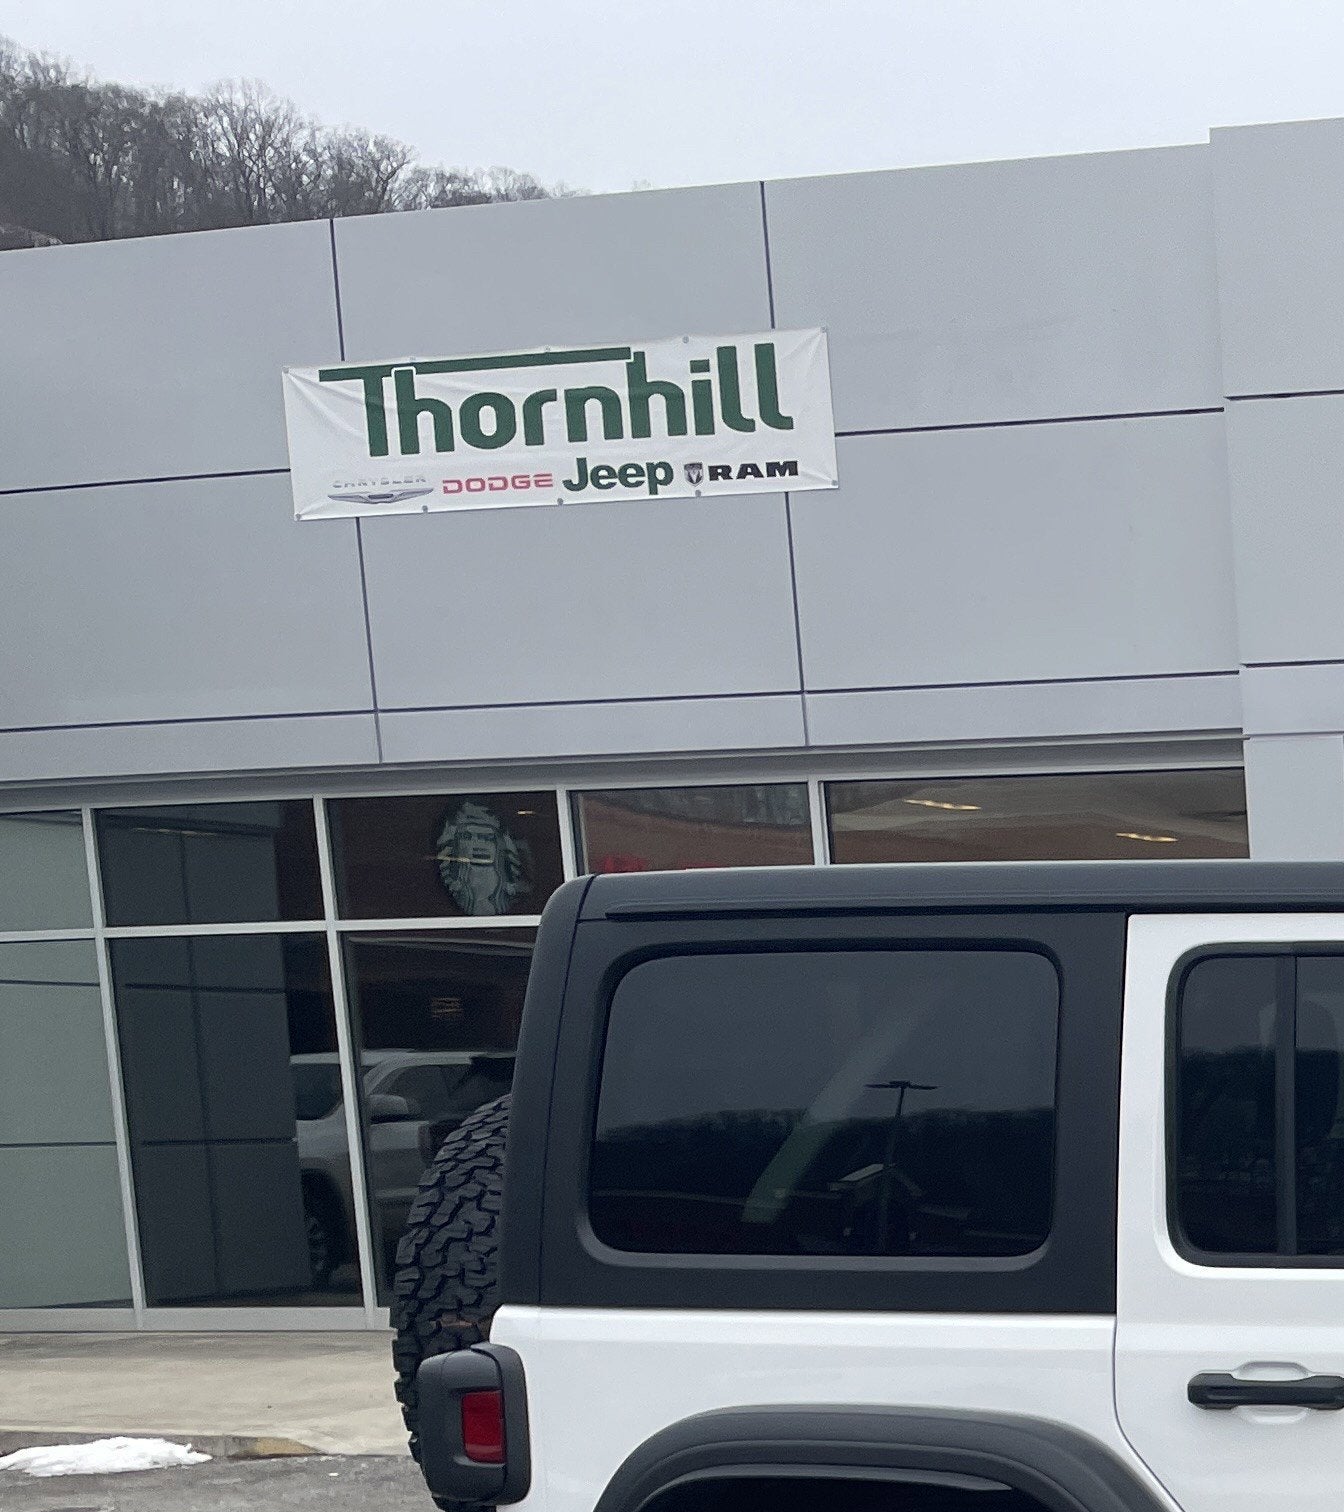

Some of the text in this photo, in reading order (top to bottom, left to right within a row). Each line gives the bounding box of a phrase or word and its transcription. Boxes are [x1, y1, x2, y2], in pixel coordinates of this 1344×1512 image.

[319, 342, 795, 457] Thornhill
[442, 473, 554, 494] DODGE
[562, 457, 675, 496] Jeep
[708, 460, 799, 482] RAM
